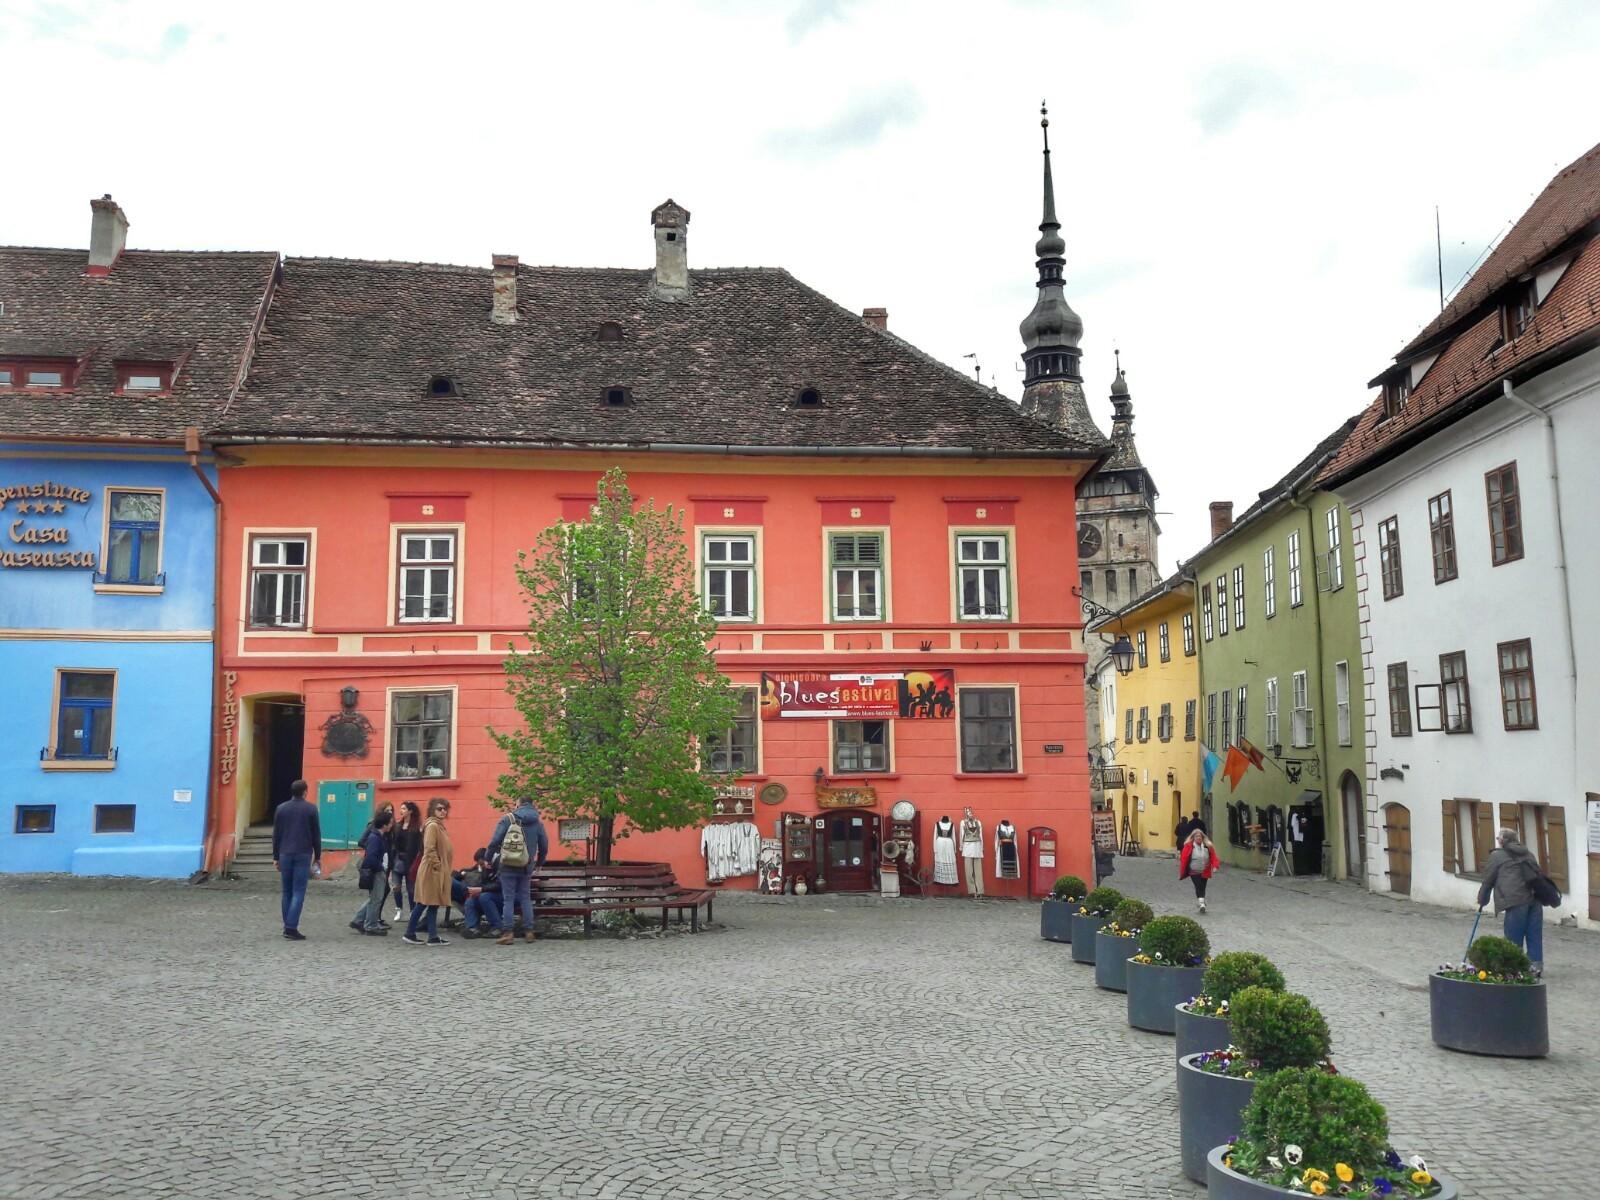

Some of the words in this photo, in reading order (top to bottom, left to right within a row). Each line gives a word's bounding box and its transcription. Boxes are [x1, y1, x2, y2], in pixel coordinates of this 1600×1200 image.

[9, 519, 69, 543] Casa
[0, 550, 96, 567] aseasca
[780, 680, 840, 705] blues
[221, 671, 237, 785] pensiune
